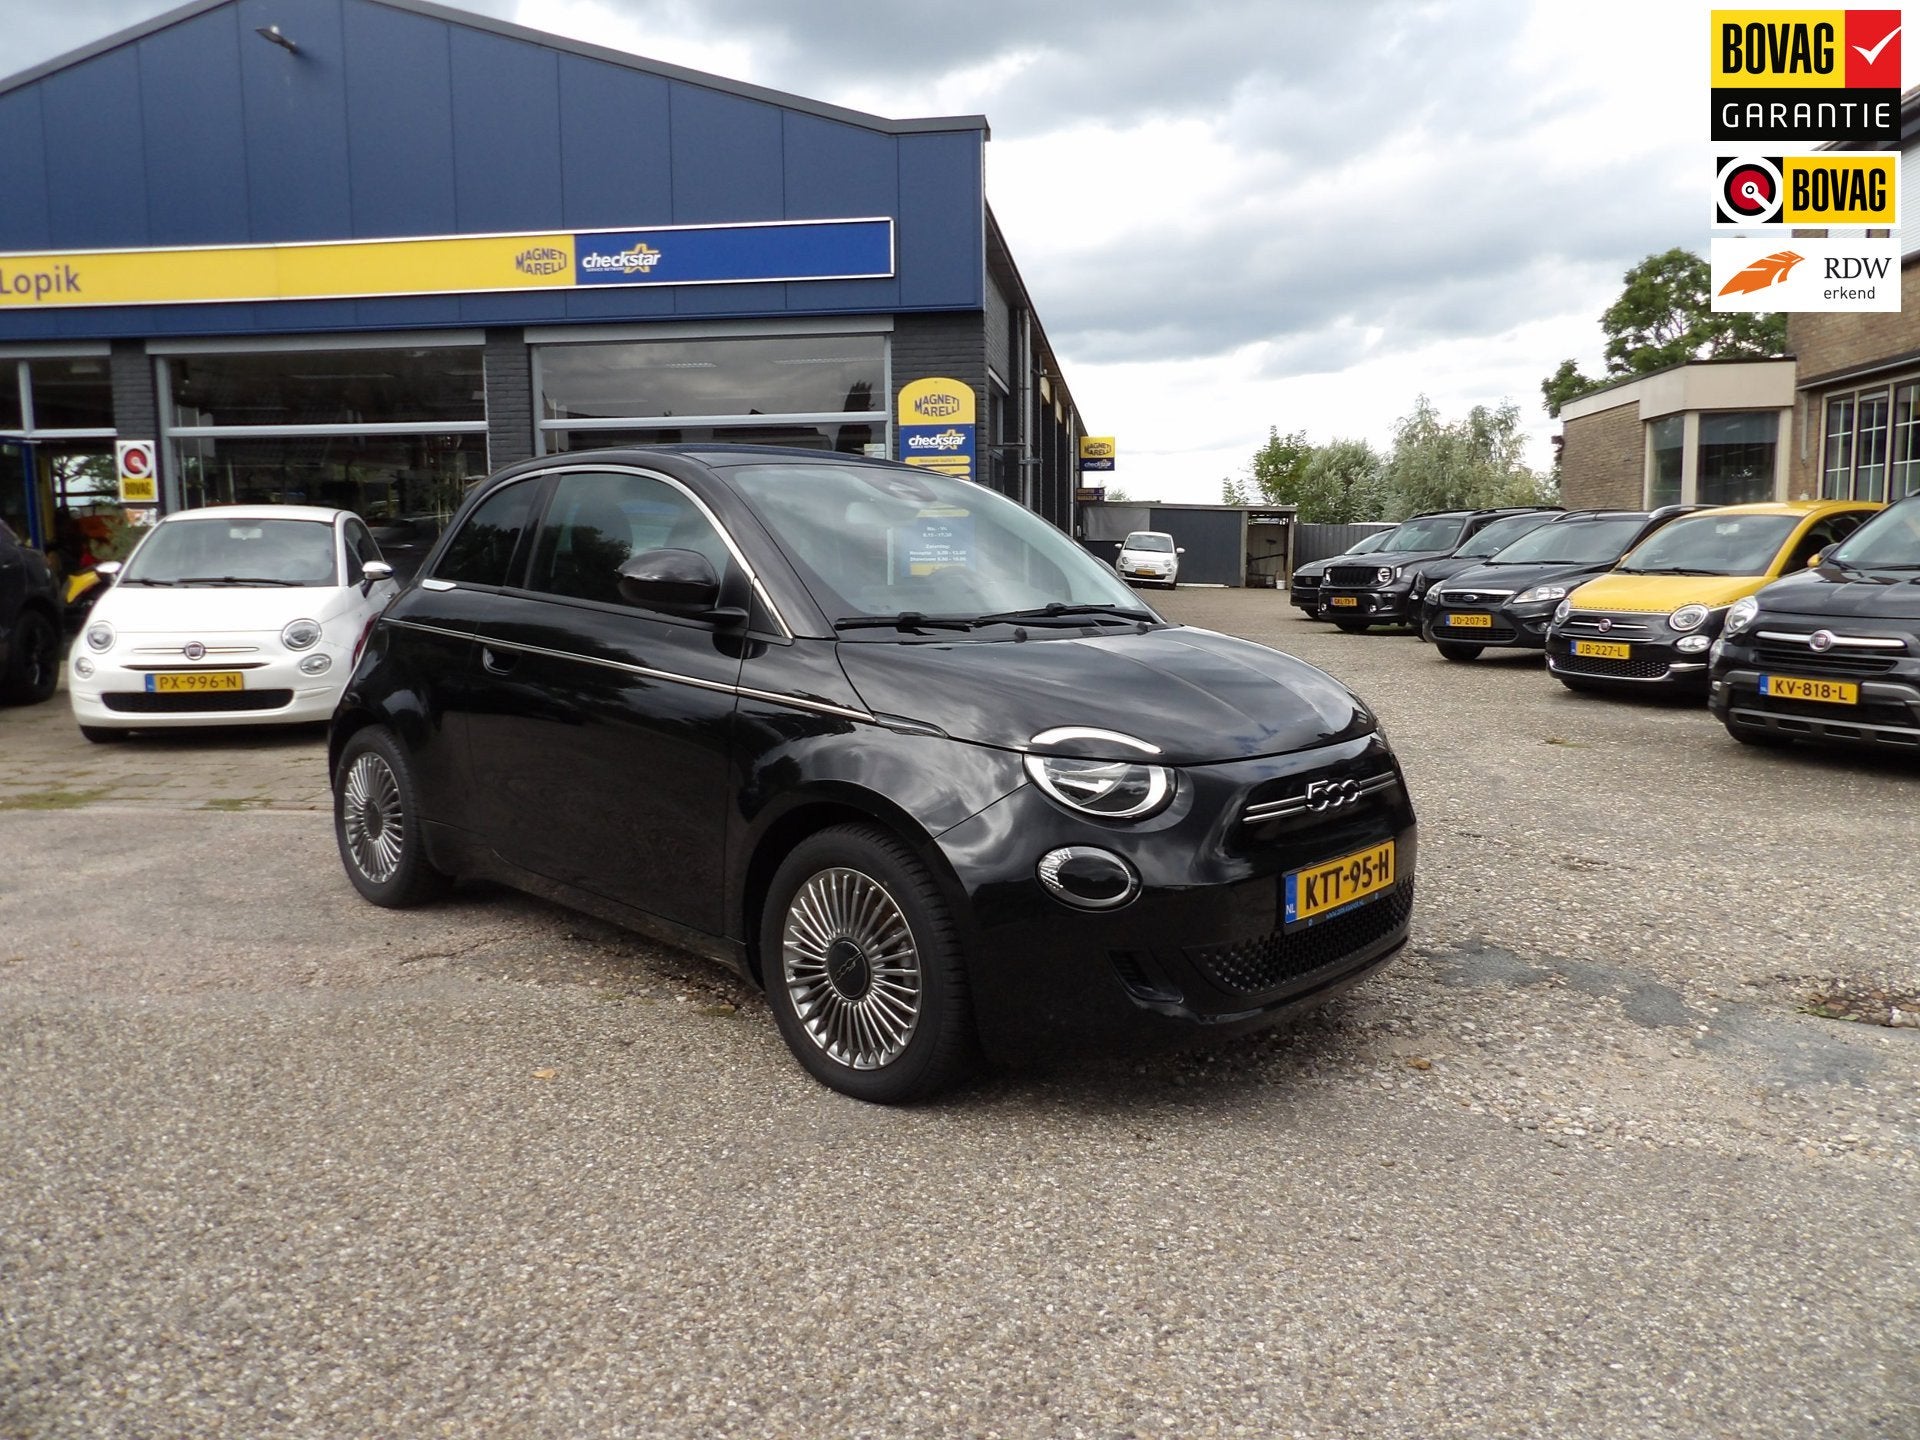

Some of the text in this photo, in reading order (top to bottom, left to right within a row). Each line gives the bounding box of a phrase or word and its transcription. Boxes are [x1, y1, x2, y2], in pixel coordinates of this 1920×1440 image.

[582, 251, 662, 268] checkstar
[0, 264, 82, 301] Lopik
[908, 434, 966, 446] checkstar
[1452, 616, 1488, 625] JD-207-B
[1580, 643, 1624, 657] JB-227-L
[159, 675, 237, 689] PX-996-N
[1775, 679, 1847, 700] KV-818-L
[1305, 779, 1363, 812] 500
[1285, 902, 1296, 914] NL
[1305, 848, 1389, 910] KTT-95-H
